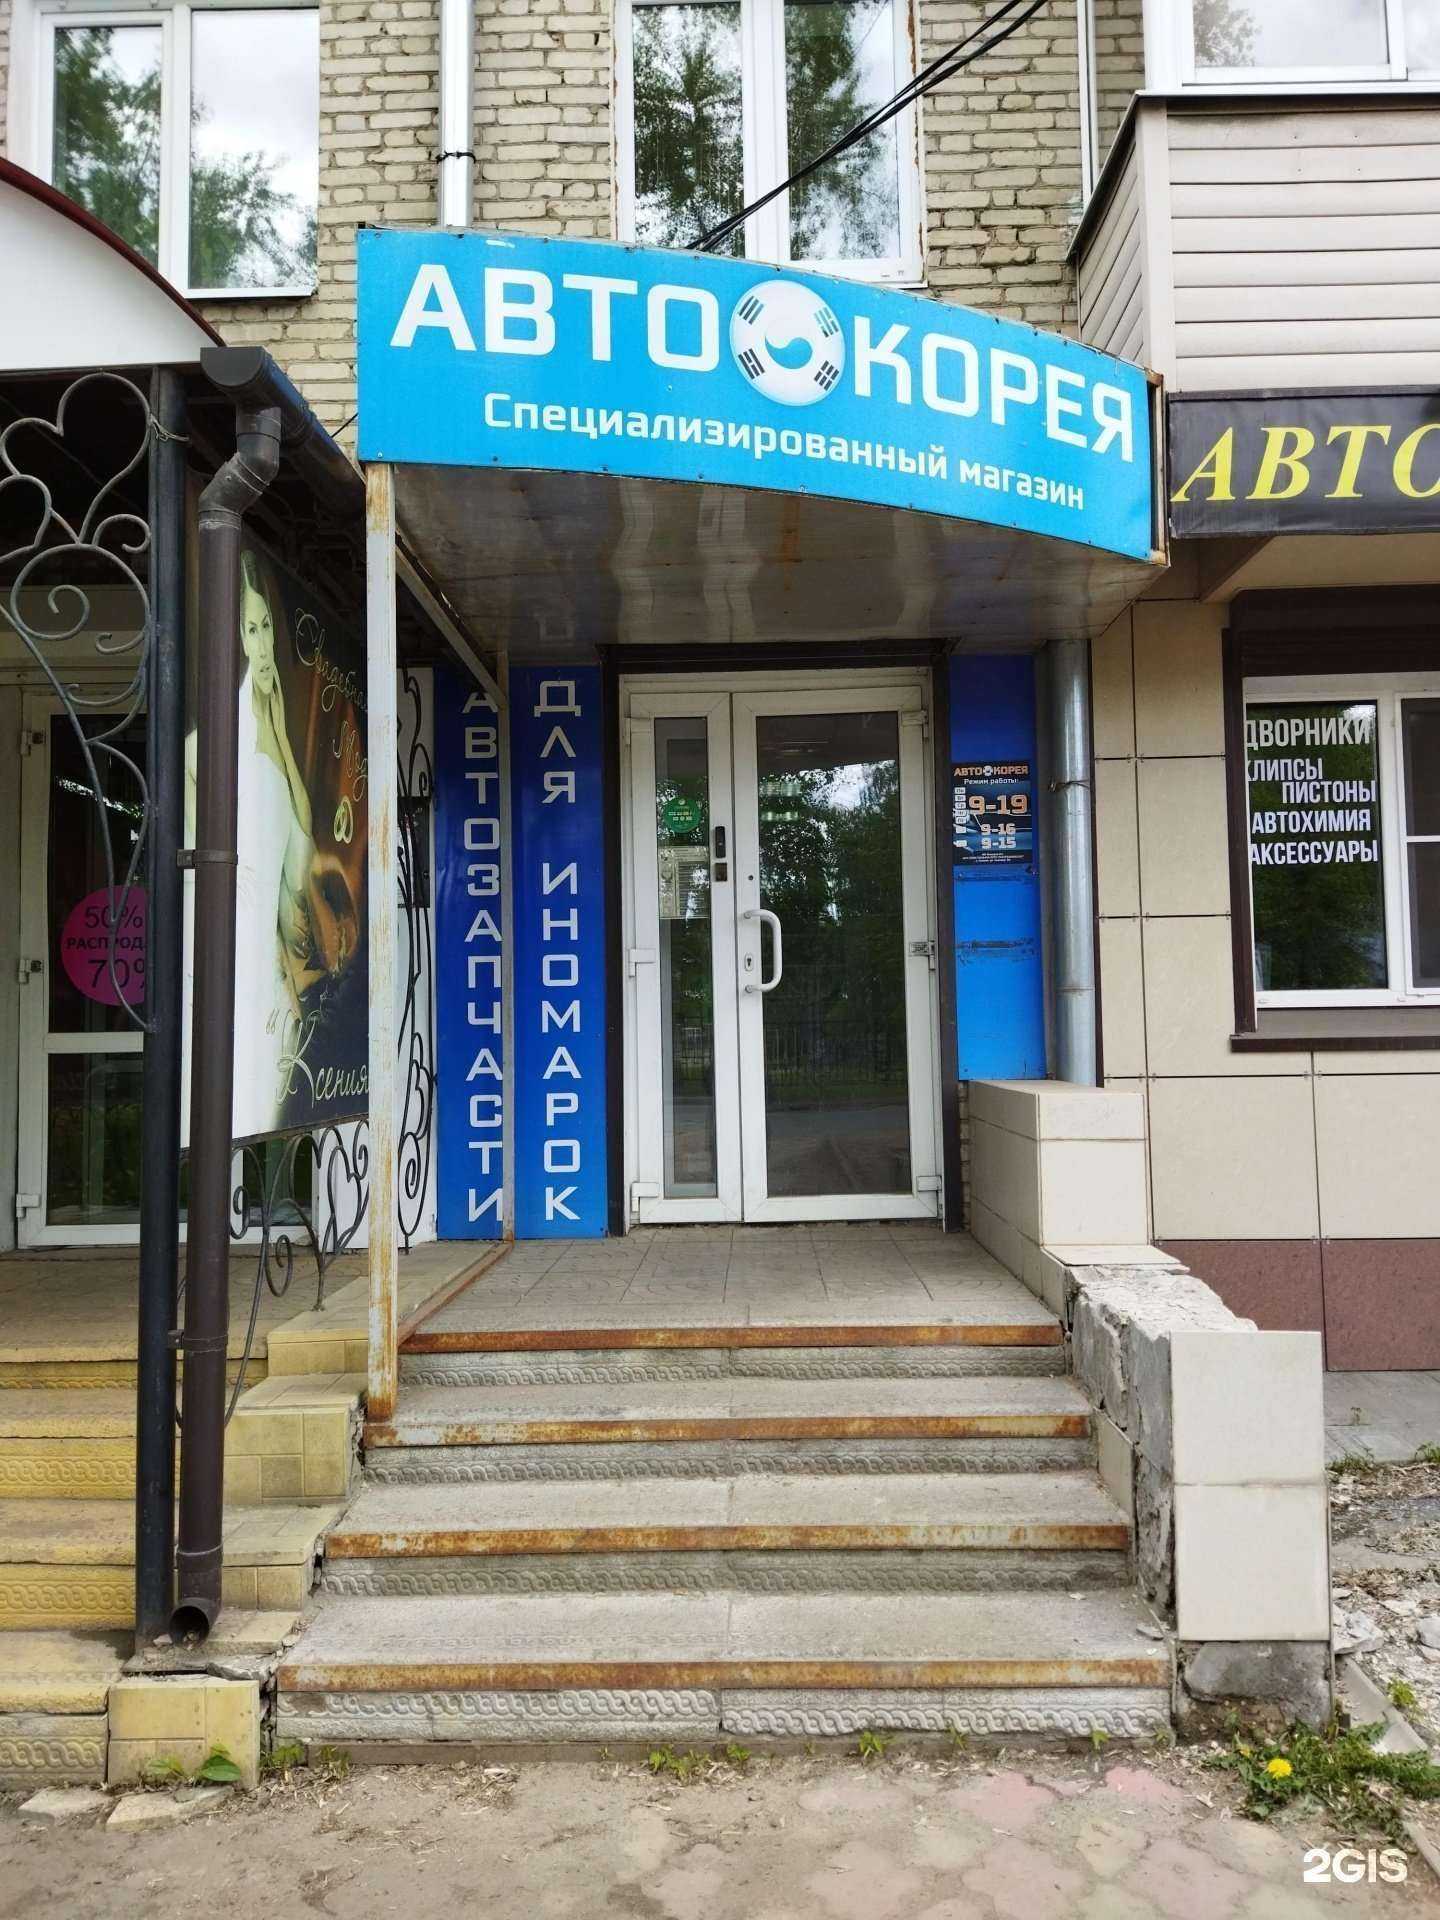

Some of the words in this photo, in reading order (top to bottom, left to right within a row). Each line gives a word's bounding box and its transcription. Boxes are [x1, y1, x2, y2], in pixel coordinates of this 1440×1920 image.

[390, 264, 720, 372] АВТО
[854, 317, 1134, 462] КОРЕЯ
[483, 393, 947, 480] Специализированный
[959, 459, 1084, 511] магазин
[534, 680, 582, 803] ДЛЯ
[1246, 717, 1371, 751] ДВОРНИКИ
[953, 766, 983, 777] АВТО
[993, 765, 1029, 776] КОРЕЯ
[968, 794, 1028, 815] 9-19
[1282, 780, 1377, 804] ПИСТОНЫ
[980, 823, 1017, 835] 9-16
[1252, 809, 1371, 834] АВТОХИМИЯ
[1250, 839, 1378, 865] АКСЕССУАРЫ
[462, 690, 504, 1222] АВТОЗАПЧАСТИ
[541, 861, 582, 1221] ИНОМАРОК
